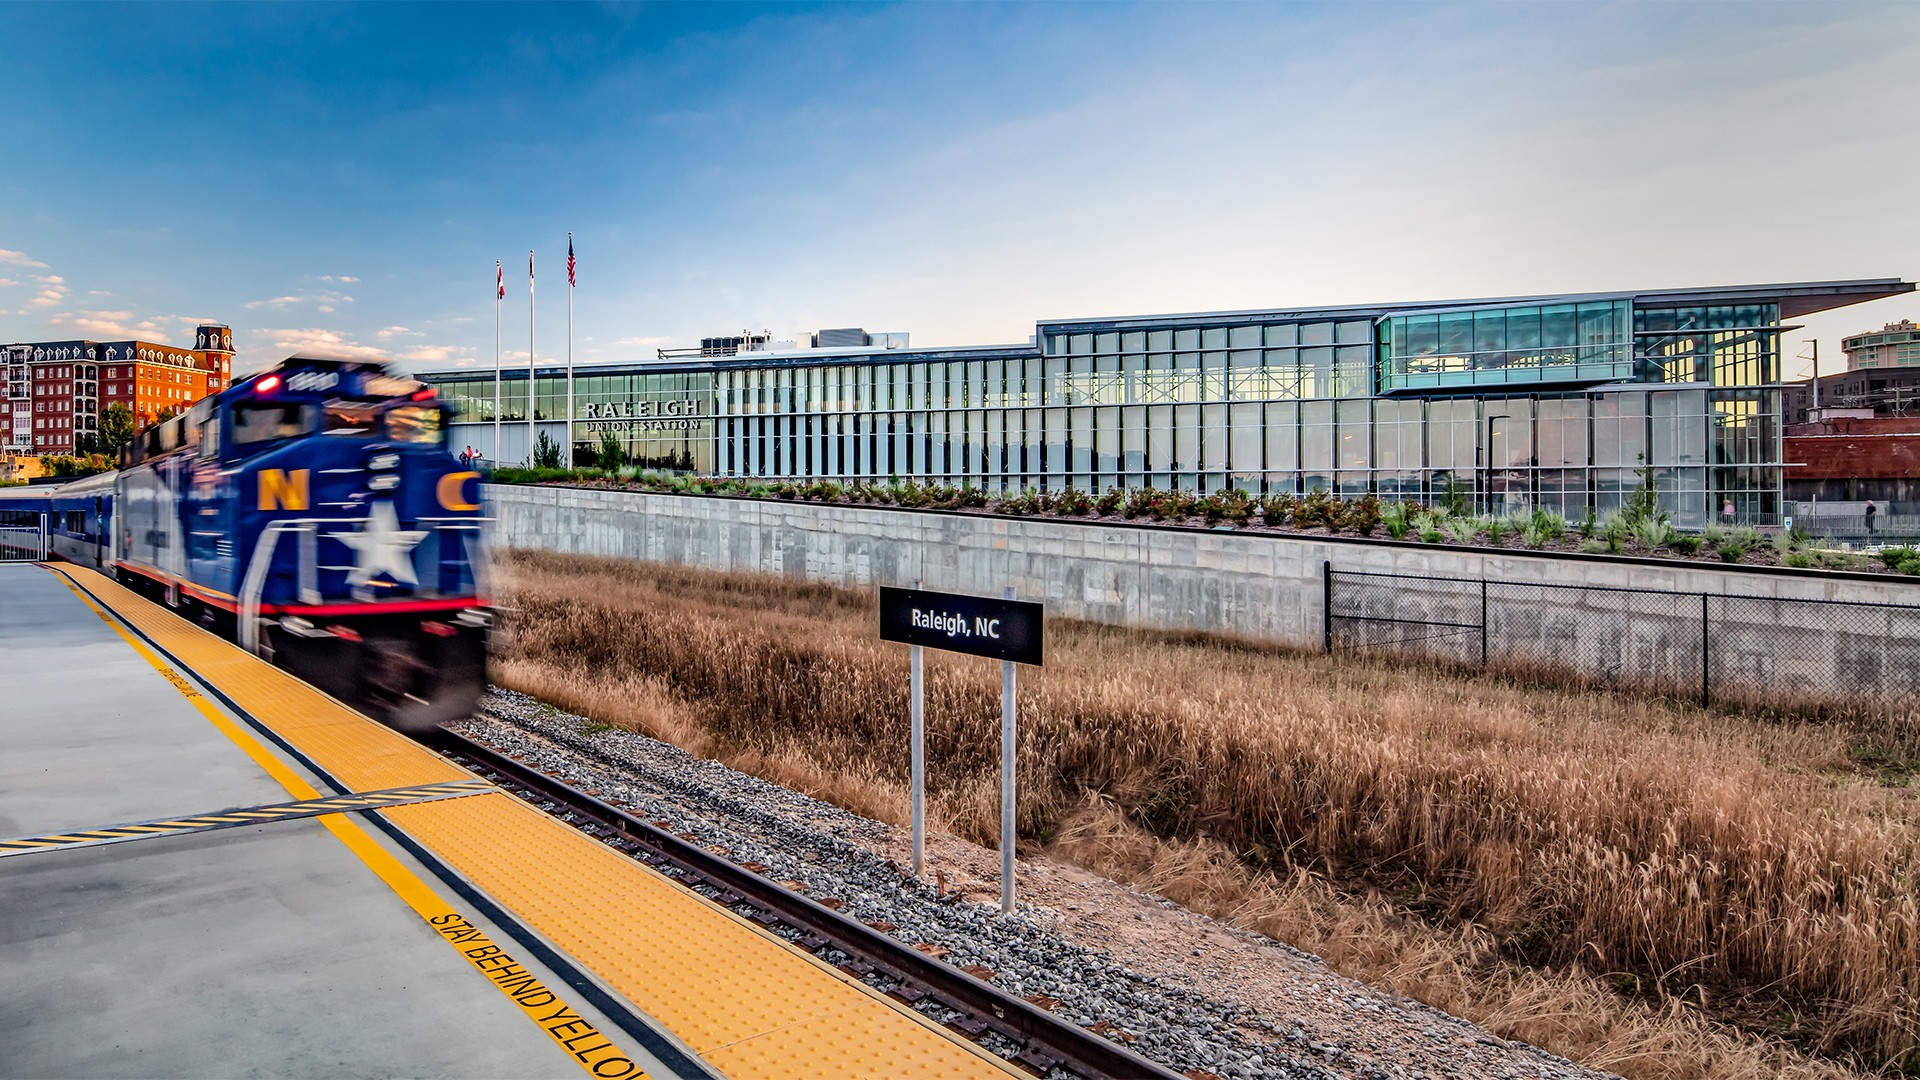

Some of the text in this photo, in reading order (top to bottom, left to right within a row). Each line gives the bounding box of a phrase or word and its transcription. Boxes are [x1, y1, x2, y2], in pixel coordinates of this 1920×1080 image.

[585, 399, 699, 418] RALEIGH
[912, 608, 1000, 639] Raleigh, NC
[430, 913, 645, 1080] STAY BEHIND YELLO
